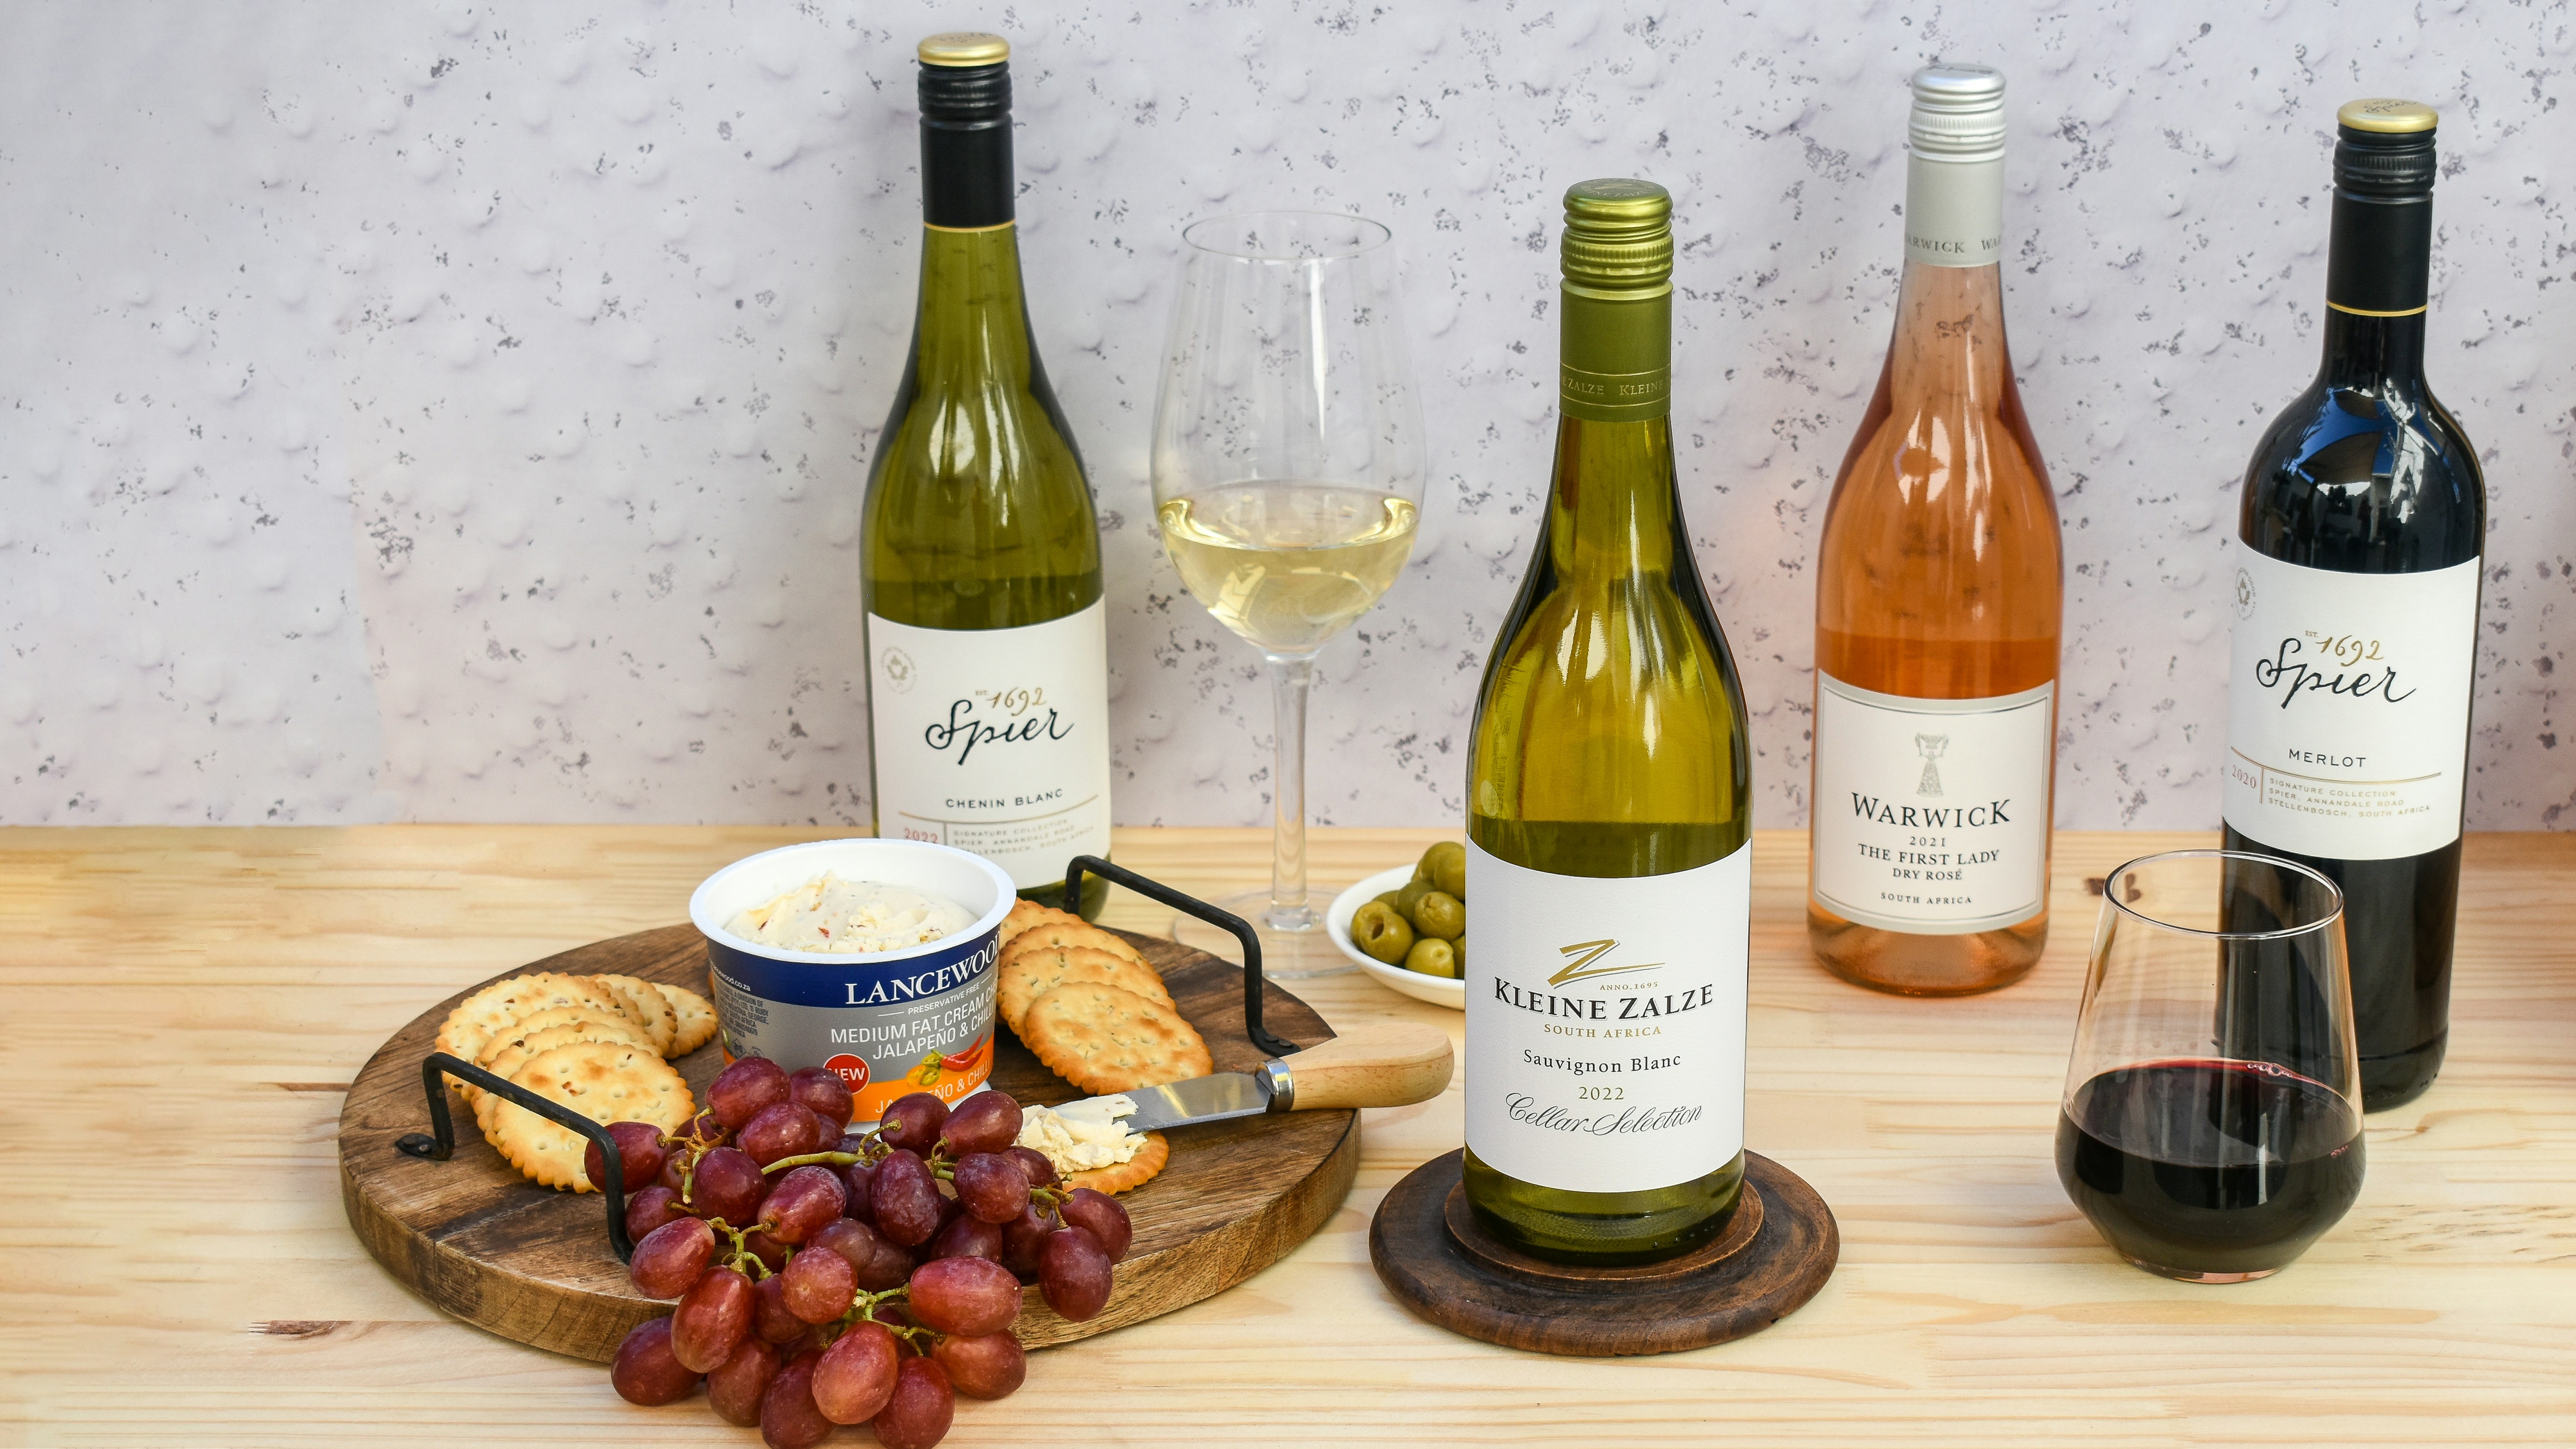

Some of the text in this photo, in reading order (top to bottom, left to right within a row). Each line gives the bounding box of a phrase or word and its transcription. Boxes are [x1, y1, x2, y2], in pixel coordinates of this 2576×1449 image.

[1568, 378, 1604, 395] ZALZE
[1619, 380, 1663, 395] KLEINE
[2305, 630, 2383, 667] EST. 1692
[2256, 638, 2416, 709] Spier
[986, 687, 1047, 716] 1692
[925, 699, 1075, 766] Spier
[2288, 749, 2366, 768] MERLOT
[2232, 764, 2256, 789] 2020
[2269, 778, 2395, 797] SIGNATURE COLLECTION
[946, 788, 1063, 809] CHENIN BLANC
[1851, 792, 2010, 828] WARWICK
[2307, 796, 2371, 807] ANNANDALE
[2398, 805, 2430, 816] AFRICA
[904, 827, 938, 844] 2022
[1909, 836, 1947, 847] 2021
[1858, 843, 1999, 865] THE FIRST LADY
[1893, 868, 1962, 881] DRY ROSÉ
[1881, 892, 1919, 903] SOUTH
[908, 983, 980, 1015] PRESERVATIVE FREE
[1495, 976, 1714, 1021] KLEINE ZALZE
[831, 1023, 907, 1043] MEDIUM
[912, 1014, 941, 1036] FAT
[945, 994, 986, 1026] CREAM
[873, 1027, 956, 1059] JALAPEÑO
[959, 1022, 968, 1037] &
[1544, 1023, 1662, 1038] SOUTH AFRICA
[1523, 1049, 1681, 1075] Sauvignon Blanc
[957, 1078, 965, 1092] &
[968, 1056, 990, 1086] CHILLI
[1578, 1086, 1624, 1100] 2022
[1505, 1092, 1702, 1136] Cellar Selection
